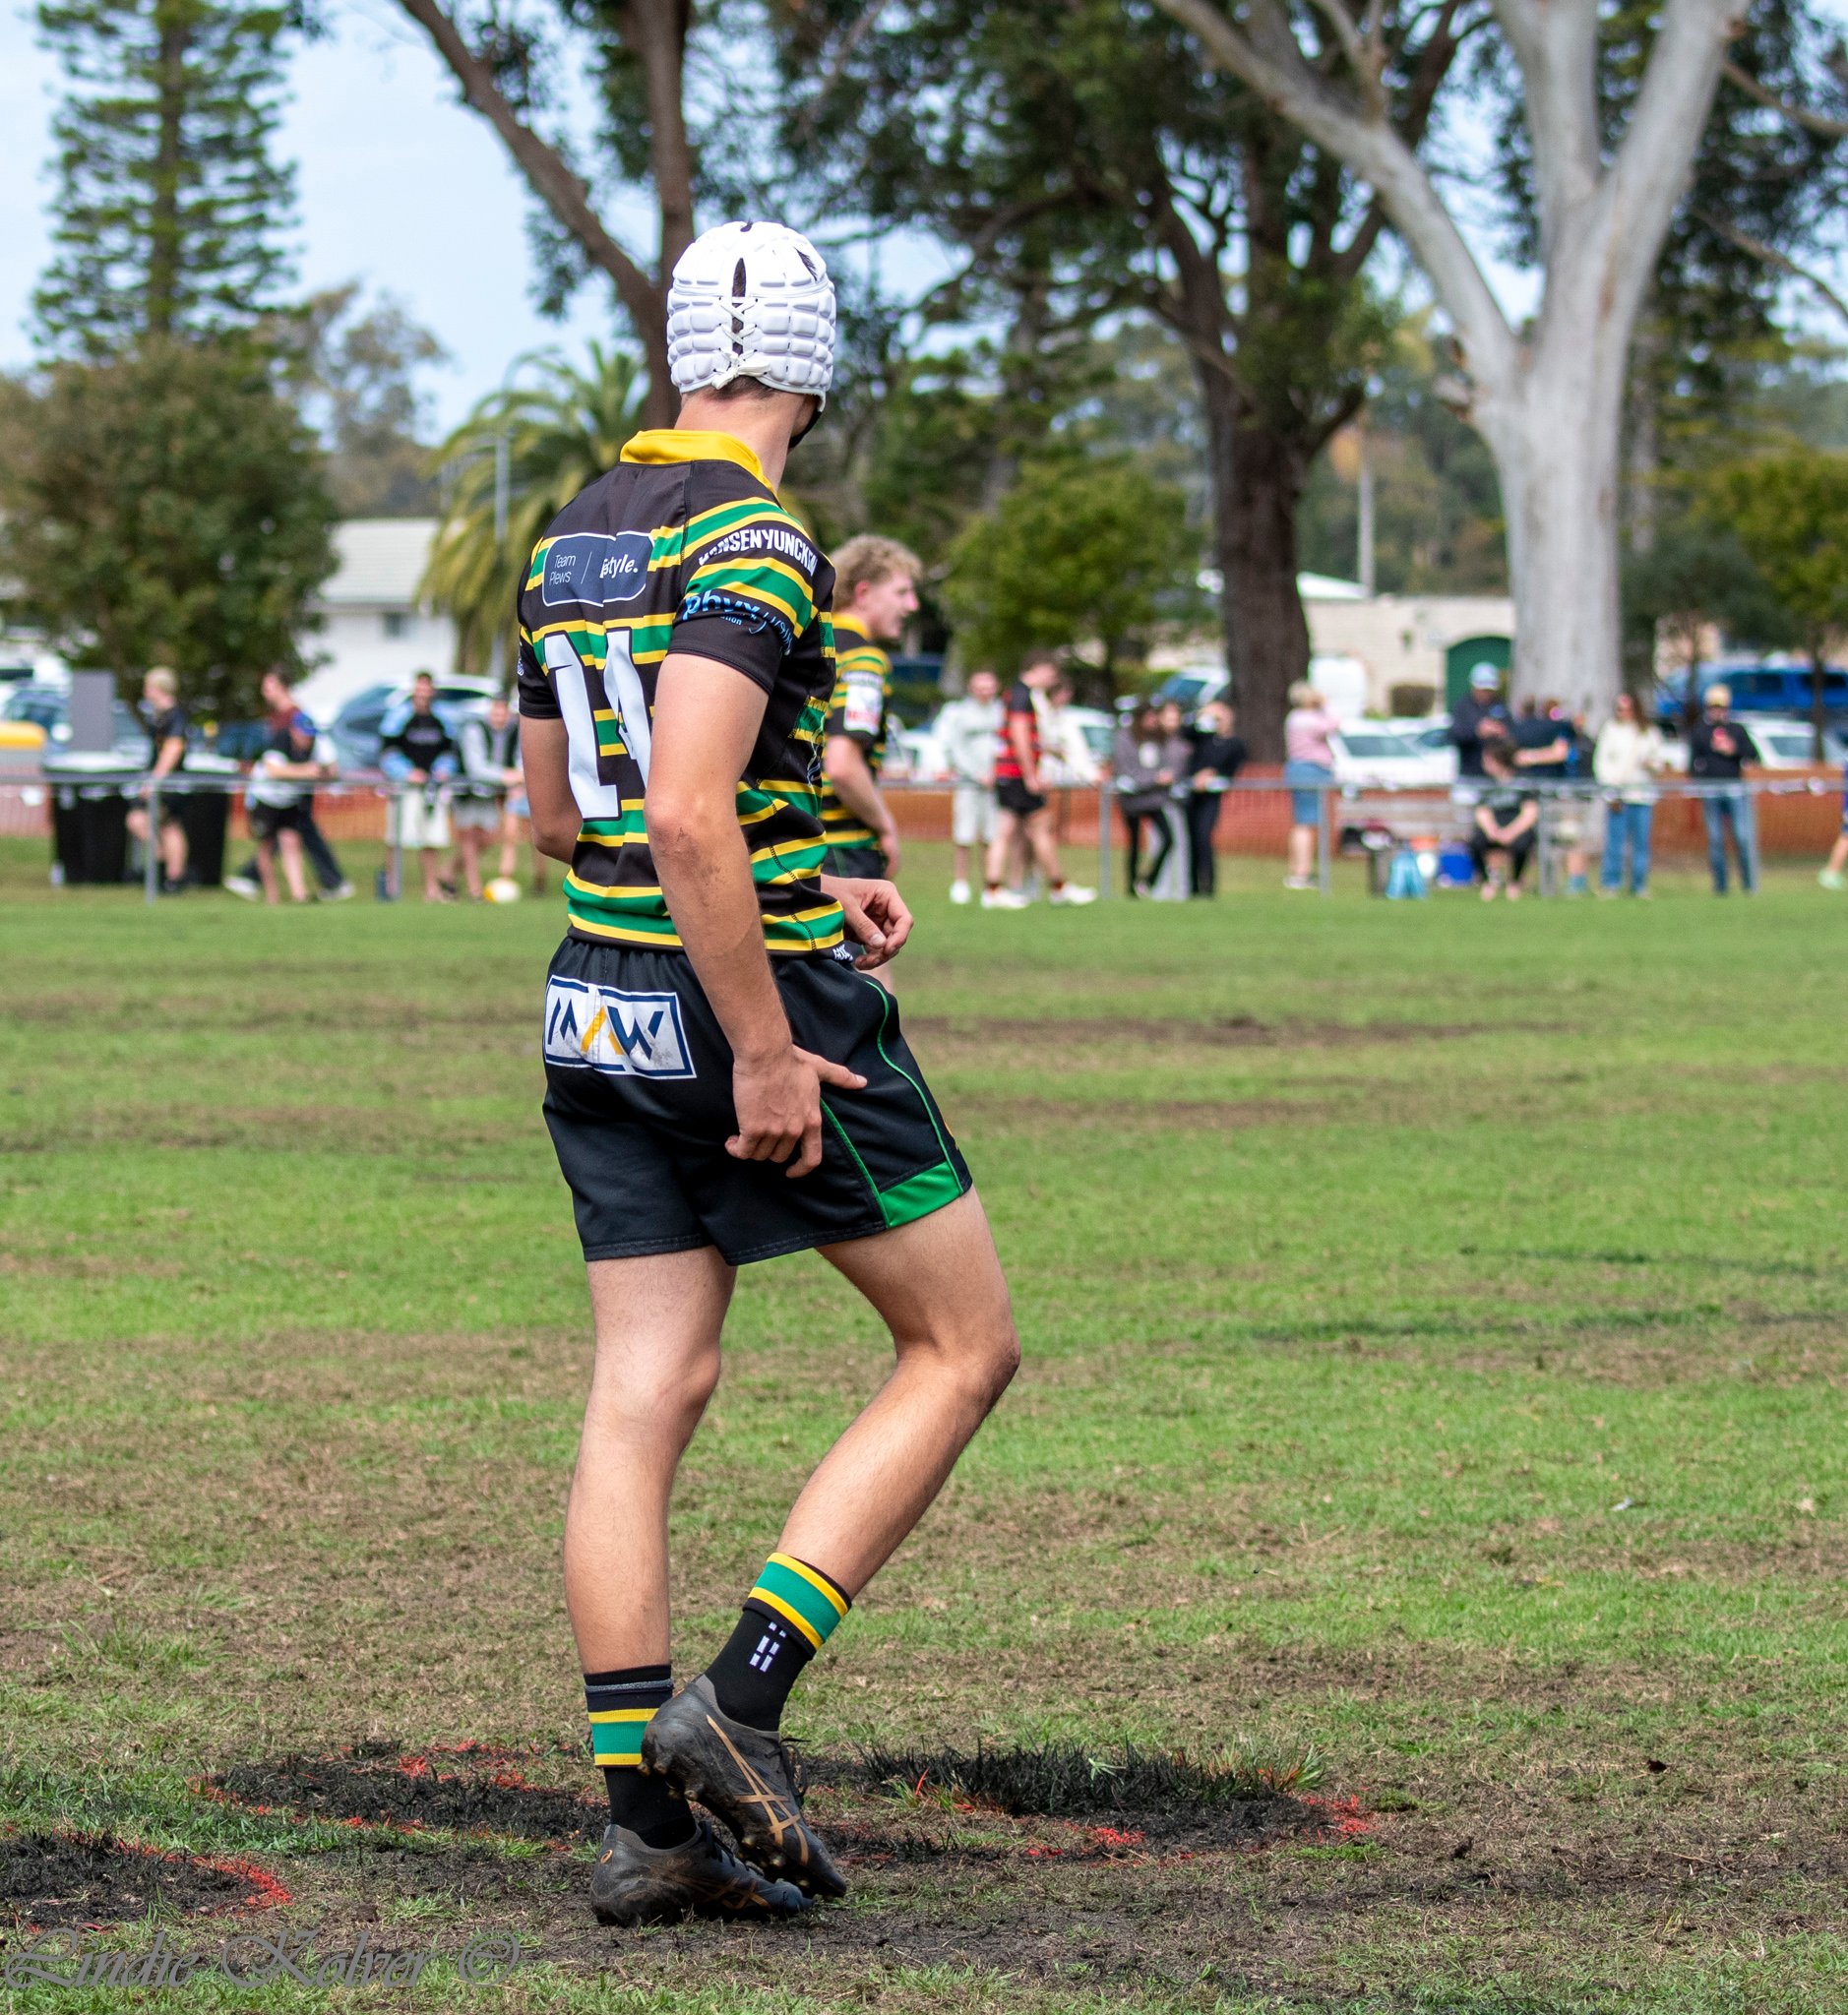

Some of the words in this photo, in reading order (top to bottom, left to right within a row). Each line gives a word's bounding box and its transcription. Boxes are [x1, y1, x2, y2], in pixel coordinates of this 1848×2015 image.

[554, 554, 577, 569] Team
[549, 571, 572, 585] Plews
[543, 628, 653, 820] 14
